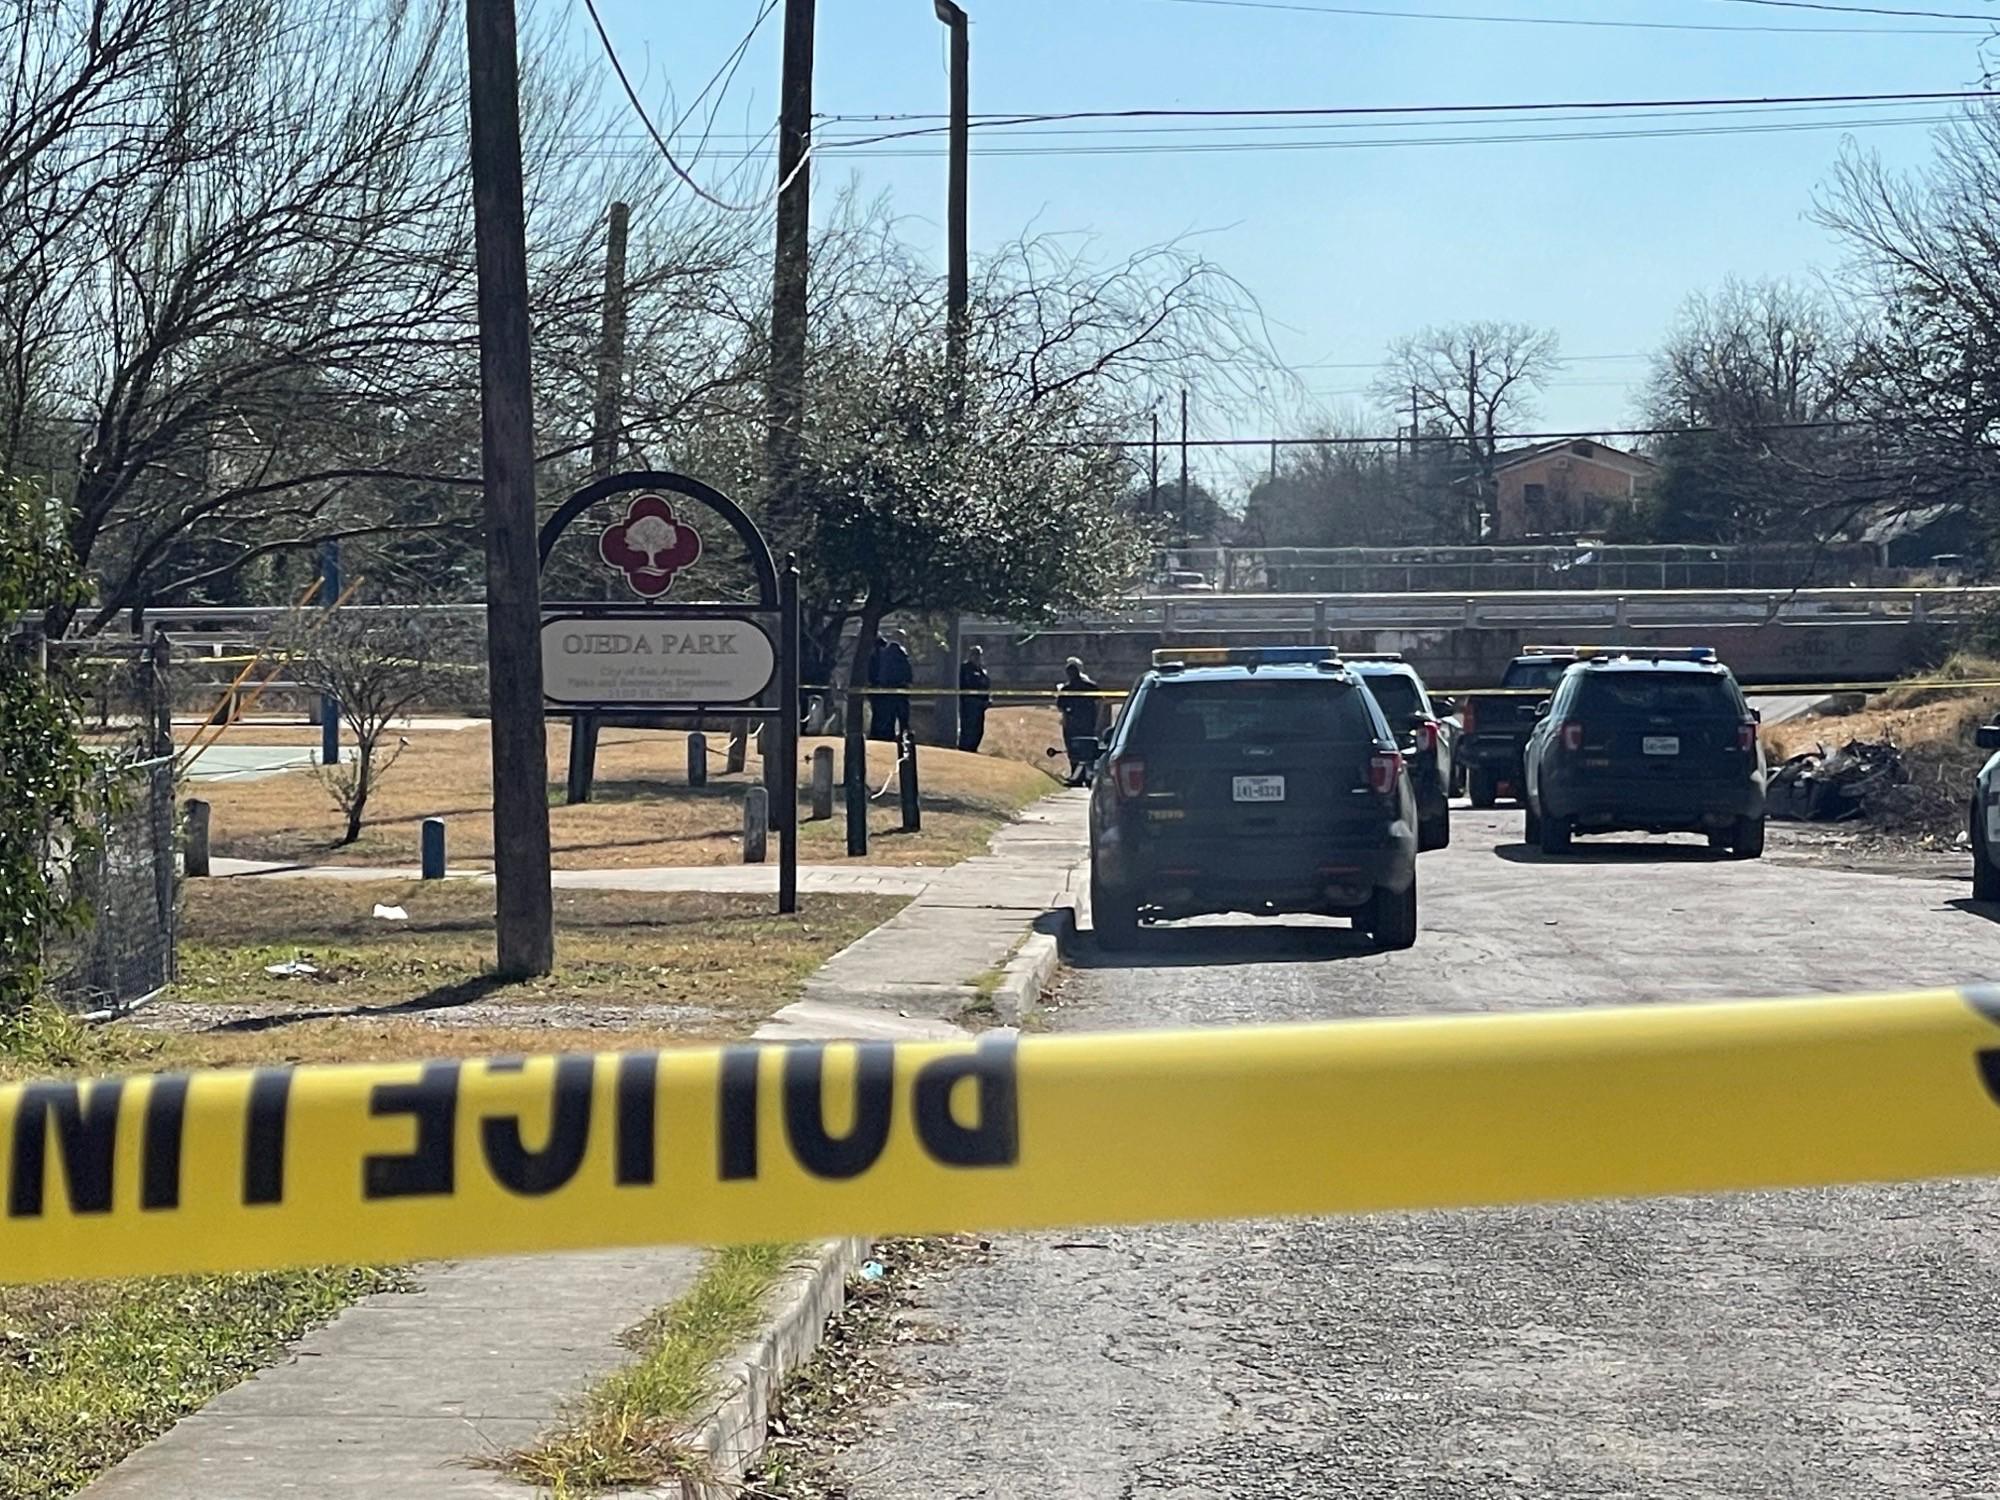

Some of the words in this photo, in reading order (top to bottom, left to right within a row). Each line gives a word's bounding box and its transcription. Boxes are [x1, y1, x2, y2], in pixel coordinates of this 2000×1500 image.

[562, 634, 653, 655] OJEDA
[661, 634, 739, 655] PARK
[600, 666, 621, 679] City
[362, 1026, 1020, 1201] POLICE
